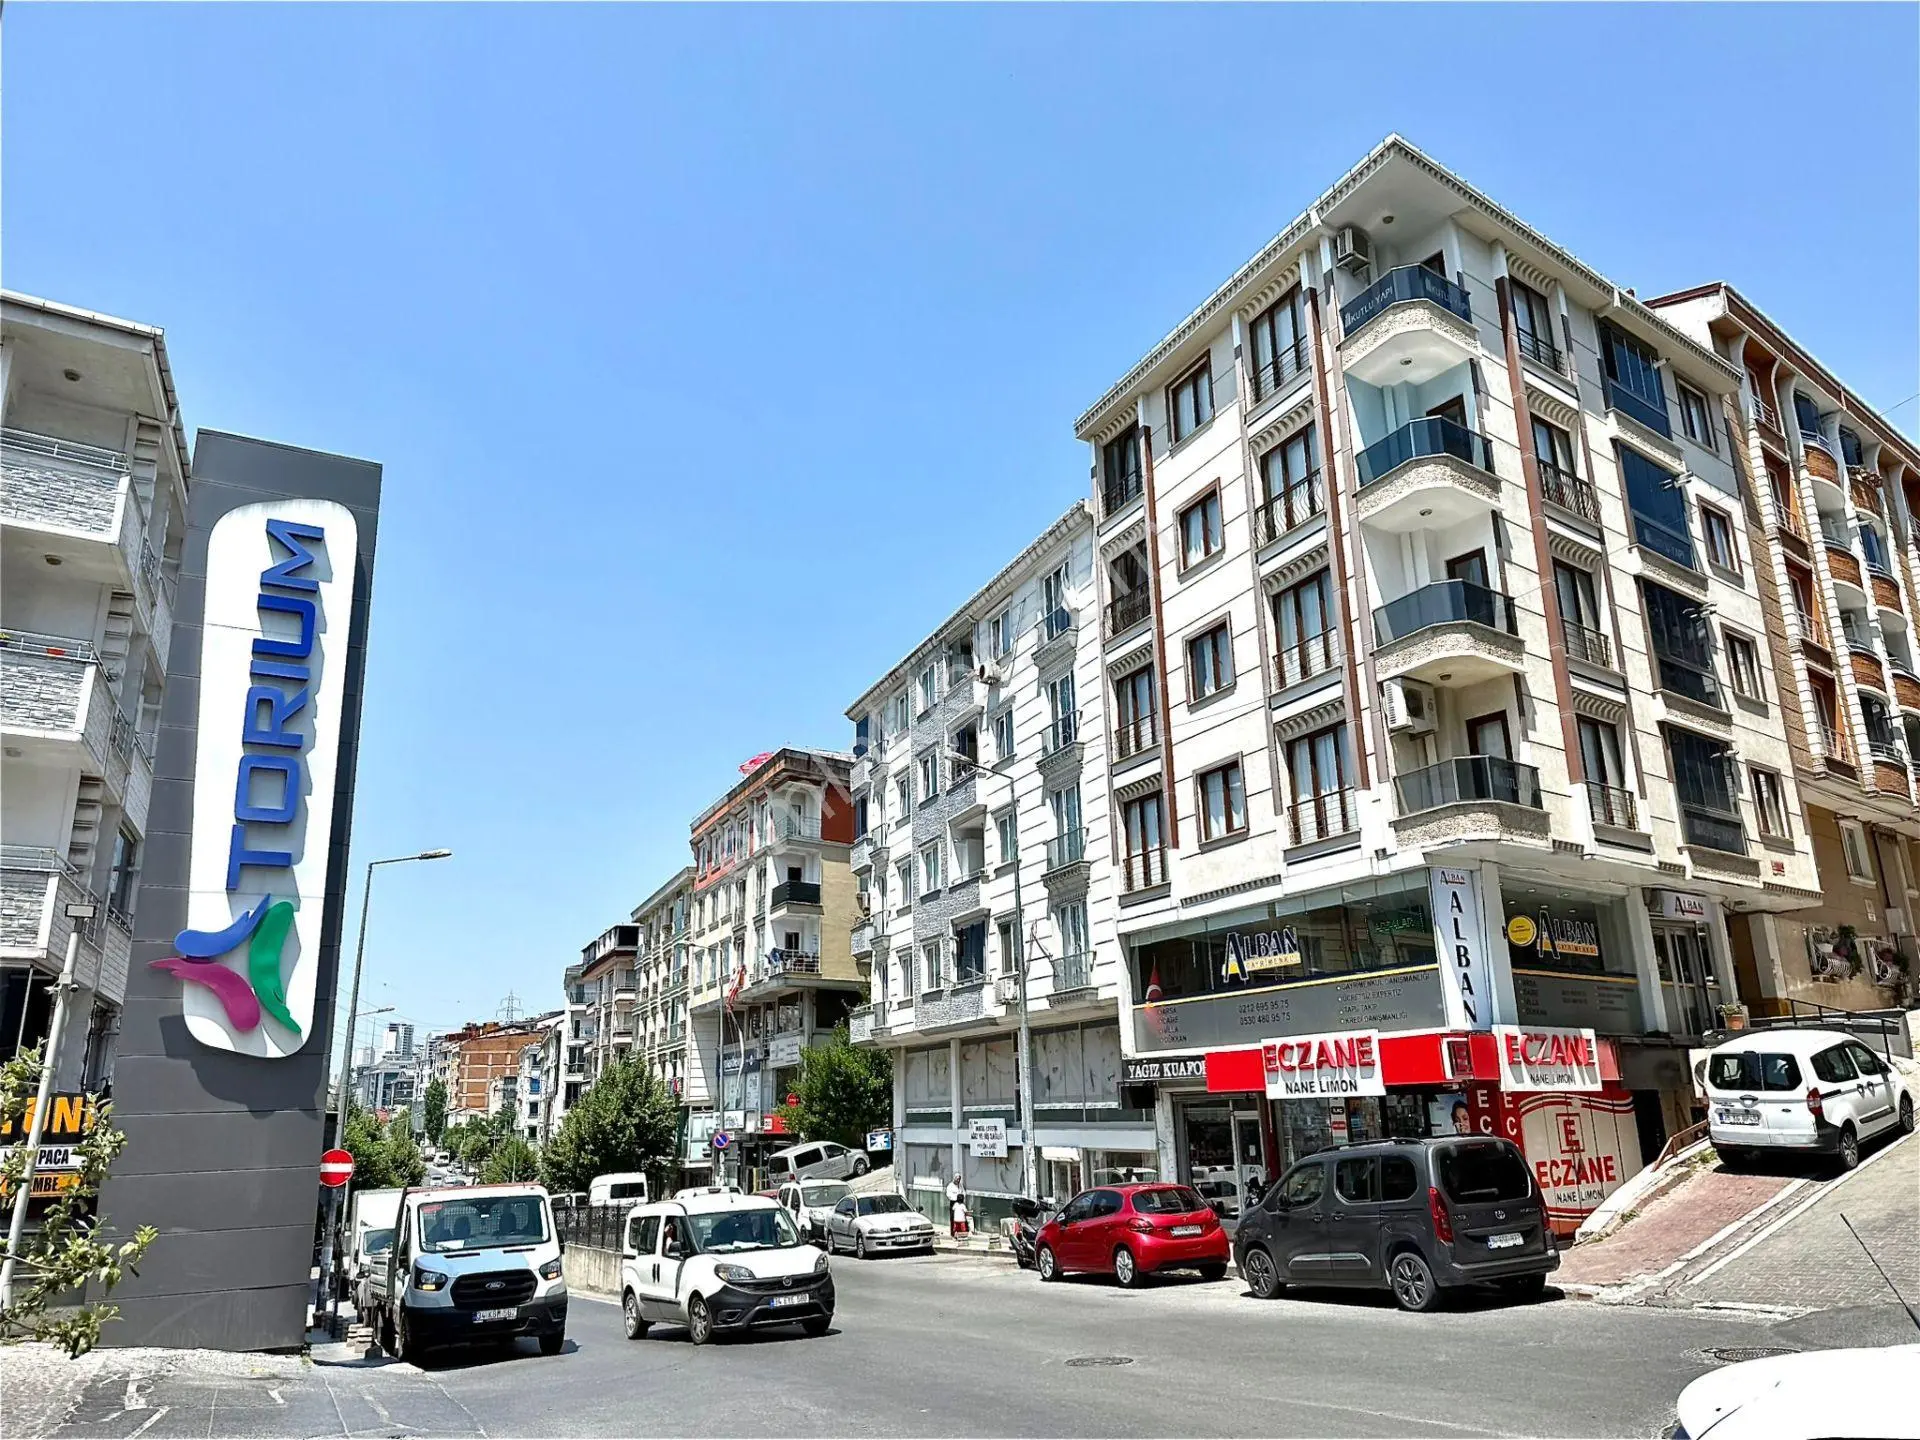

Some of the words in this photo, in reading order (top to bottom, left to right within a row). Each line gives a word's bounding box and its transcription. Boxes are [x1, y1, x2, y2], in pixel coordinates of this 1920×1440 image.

[1350, 303, 1374, 322] KUTLU
[1375, 286, 1393, 304] YAPI
[226, 518, 325, 890] TORIUM
[1675, 896, 1705, 915] ALBAN
[1538, 909, 1598, 960] ALBAN
[1223, 926, 1298, 983] ALBAN
[1449, 890, 1479, 1024] ALBAN
[1239, 1002, 1255, 1014] 0212
[1269, 1000, 1279, 1010] 95
[1240, 1015, 1256, 1026] 0530
[1271, 1012, 1281, 1022] 95
[1262, 1035, 1376, 1073] ECZANE
[1505, 1032, 1596, 1067] ECZANE
[1129, 1060, 1160, 1079] YAĞIZ
[1530, 1073, 1549, 1085] NANE
[1285, 1081, 1317, 1095] NANE
[1536, 1155, 1617, 1189] ECZANE
[1556, 1191, 1577, 1204] NANE
